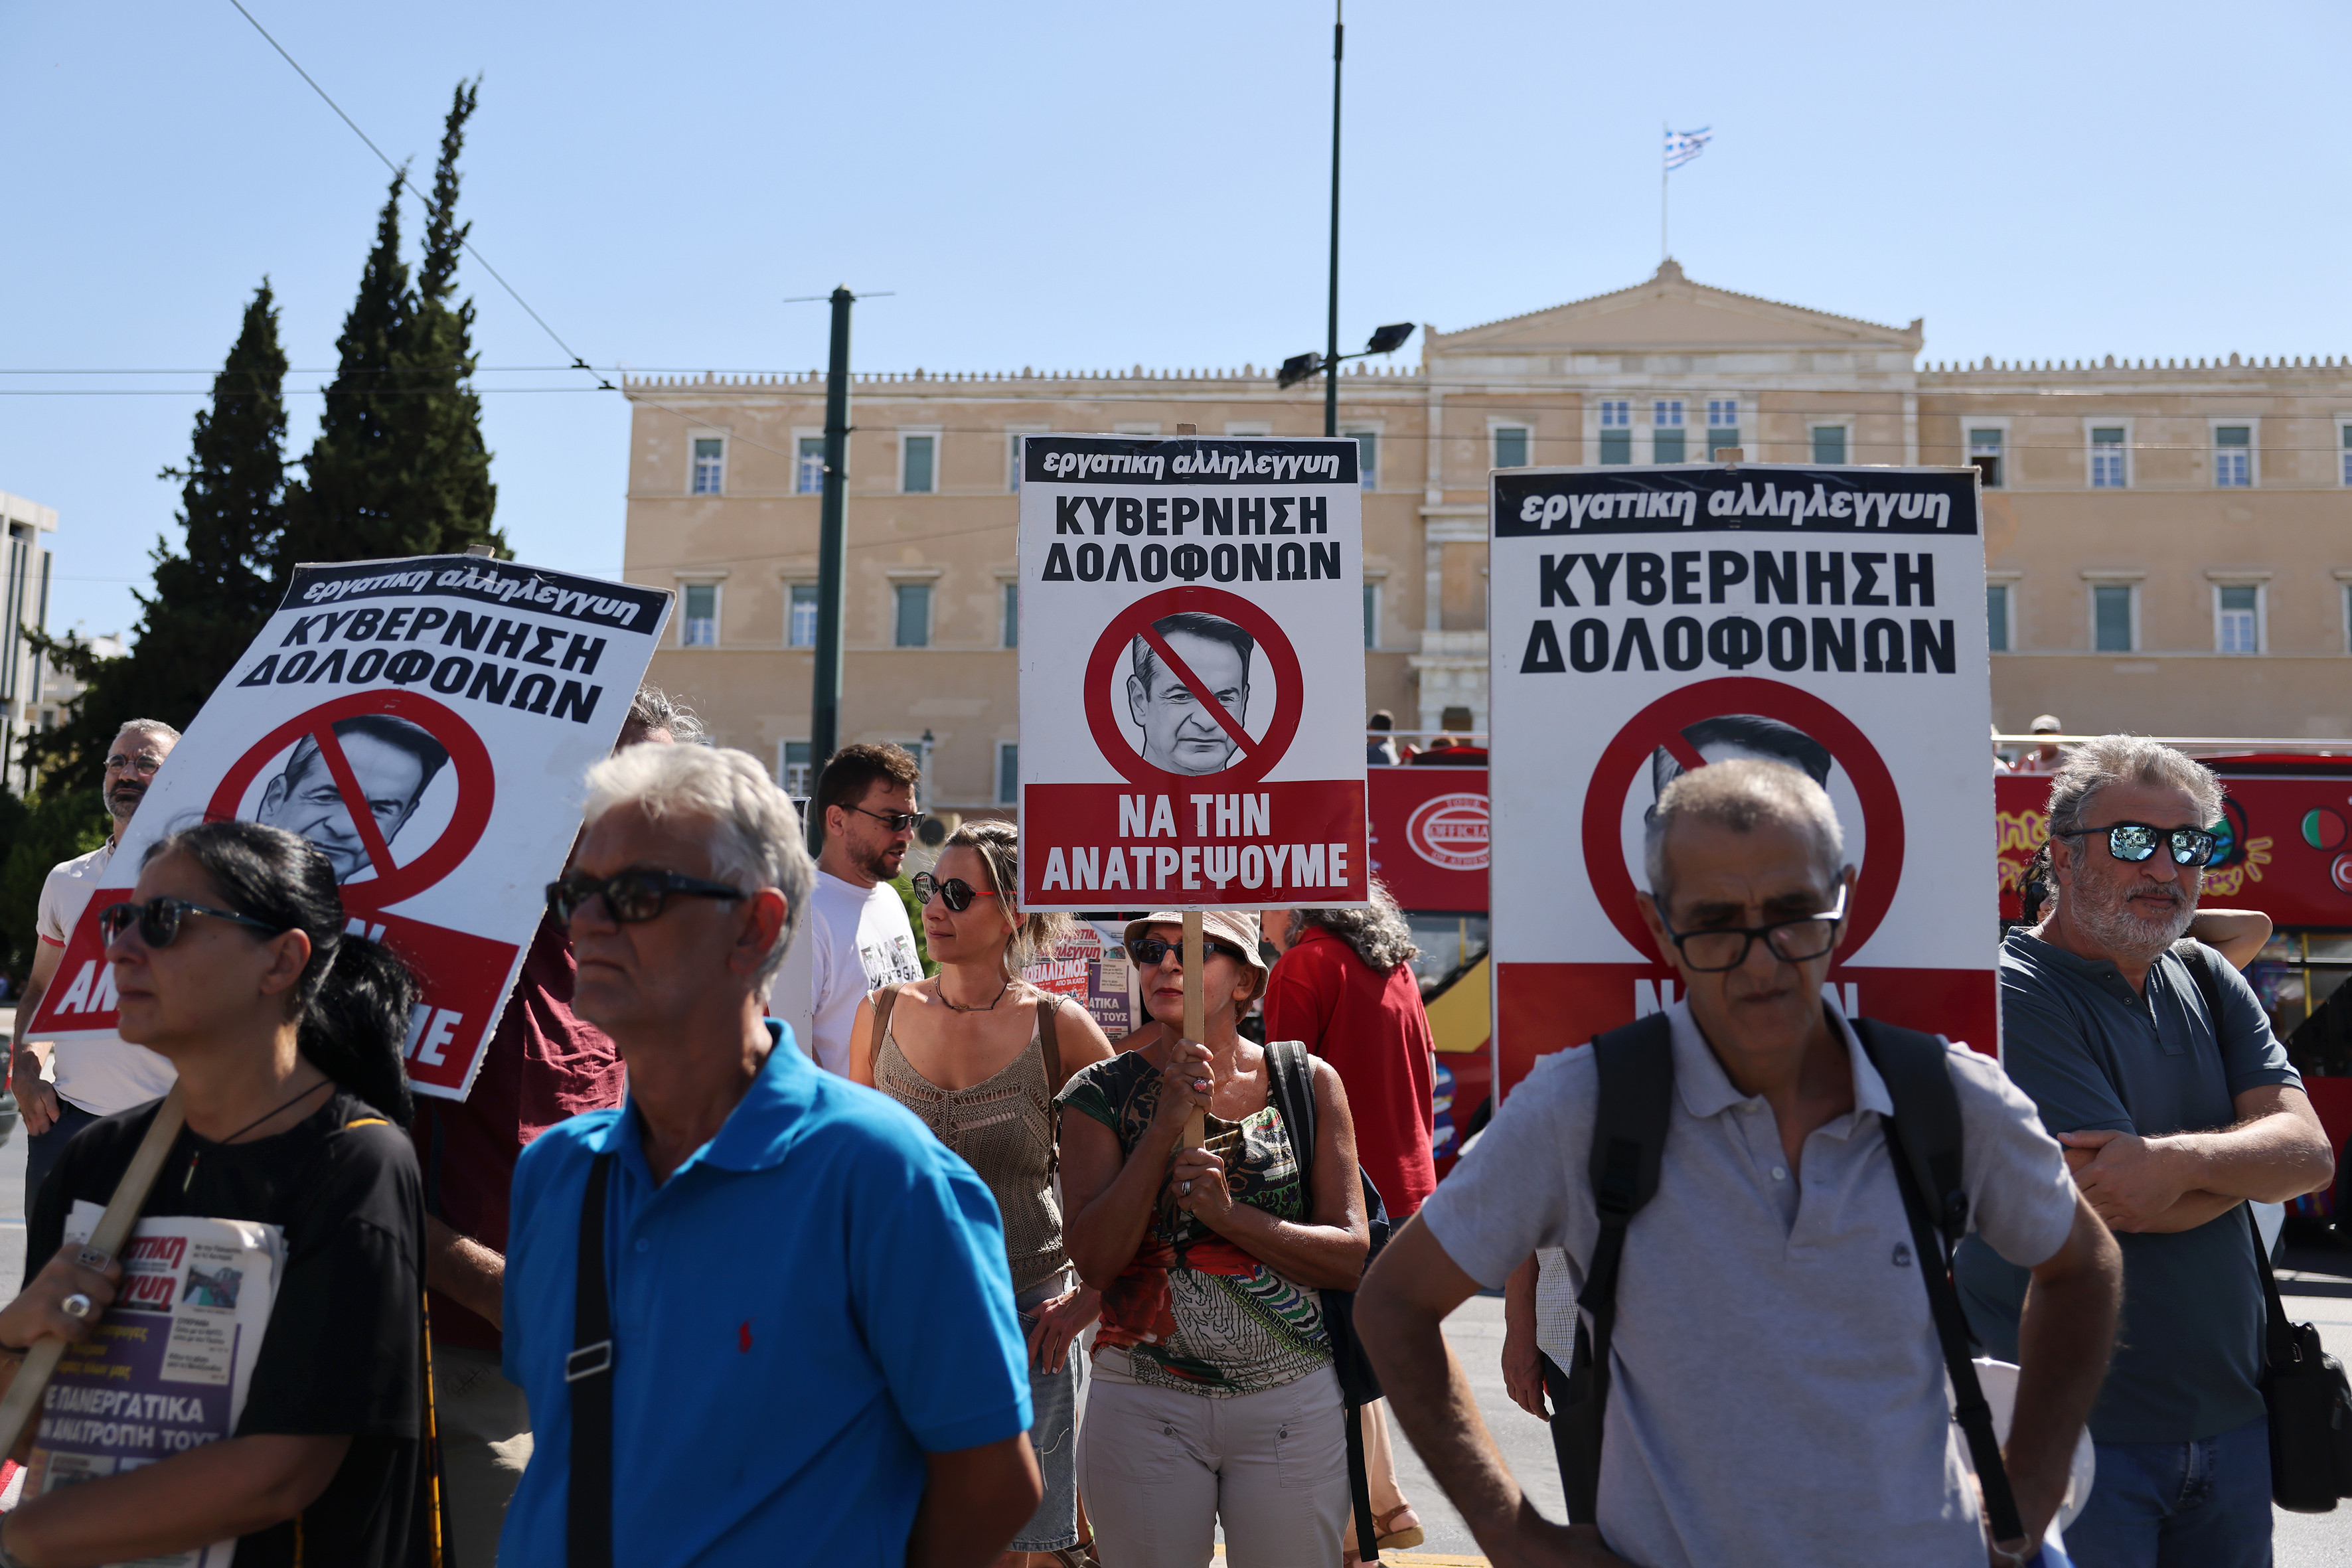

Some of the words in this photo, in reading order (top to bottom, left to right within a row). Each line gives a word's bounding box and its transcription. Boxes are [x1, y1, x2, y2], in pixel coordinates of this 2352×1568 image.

[1056, 495, 1328, 536] ΚΥΒΕΡΝΗΣΗ
[1042, 541, 1341, 582] ΔΟΛΟΦΟΝΩΝ
[1539, 550, 1935, 608] ΚΥΒΕΡΝΗΣΗ
[279, 607, 607, 676] ΚΥΒΕΡΝΗΣΗ
[1519, 616, 1956, 674] ΔΟΛΟΦΟΝΩΝ
[236, 649, 603, 724] ΔΟΛΟΦΟΝΩΝ
[1119, 794, 1176, 838] ΝΑ
[1190, 793, 1271, 836] ΤΗΝ
[1429, 824, 1489, 838] OFFICIA
[1042, 842, 1348, 891] ΑΝΑΤΡΕΨΟΥΜΕ
[1450, 854, 1489, 866] ATHEN
[1073, 977, 1086, 985] ΚΑΤΩ
[1102, 1012, 1128, 1022] ΤΟΥΣ
[57, 1385, 205, 1423] ΠΑΝΕΡΓΑΤΙΚΑ
[52, 1417, 156, 1448] ΑΝΑΤΡΟΠΗ
